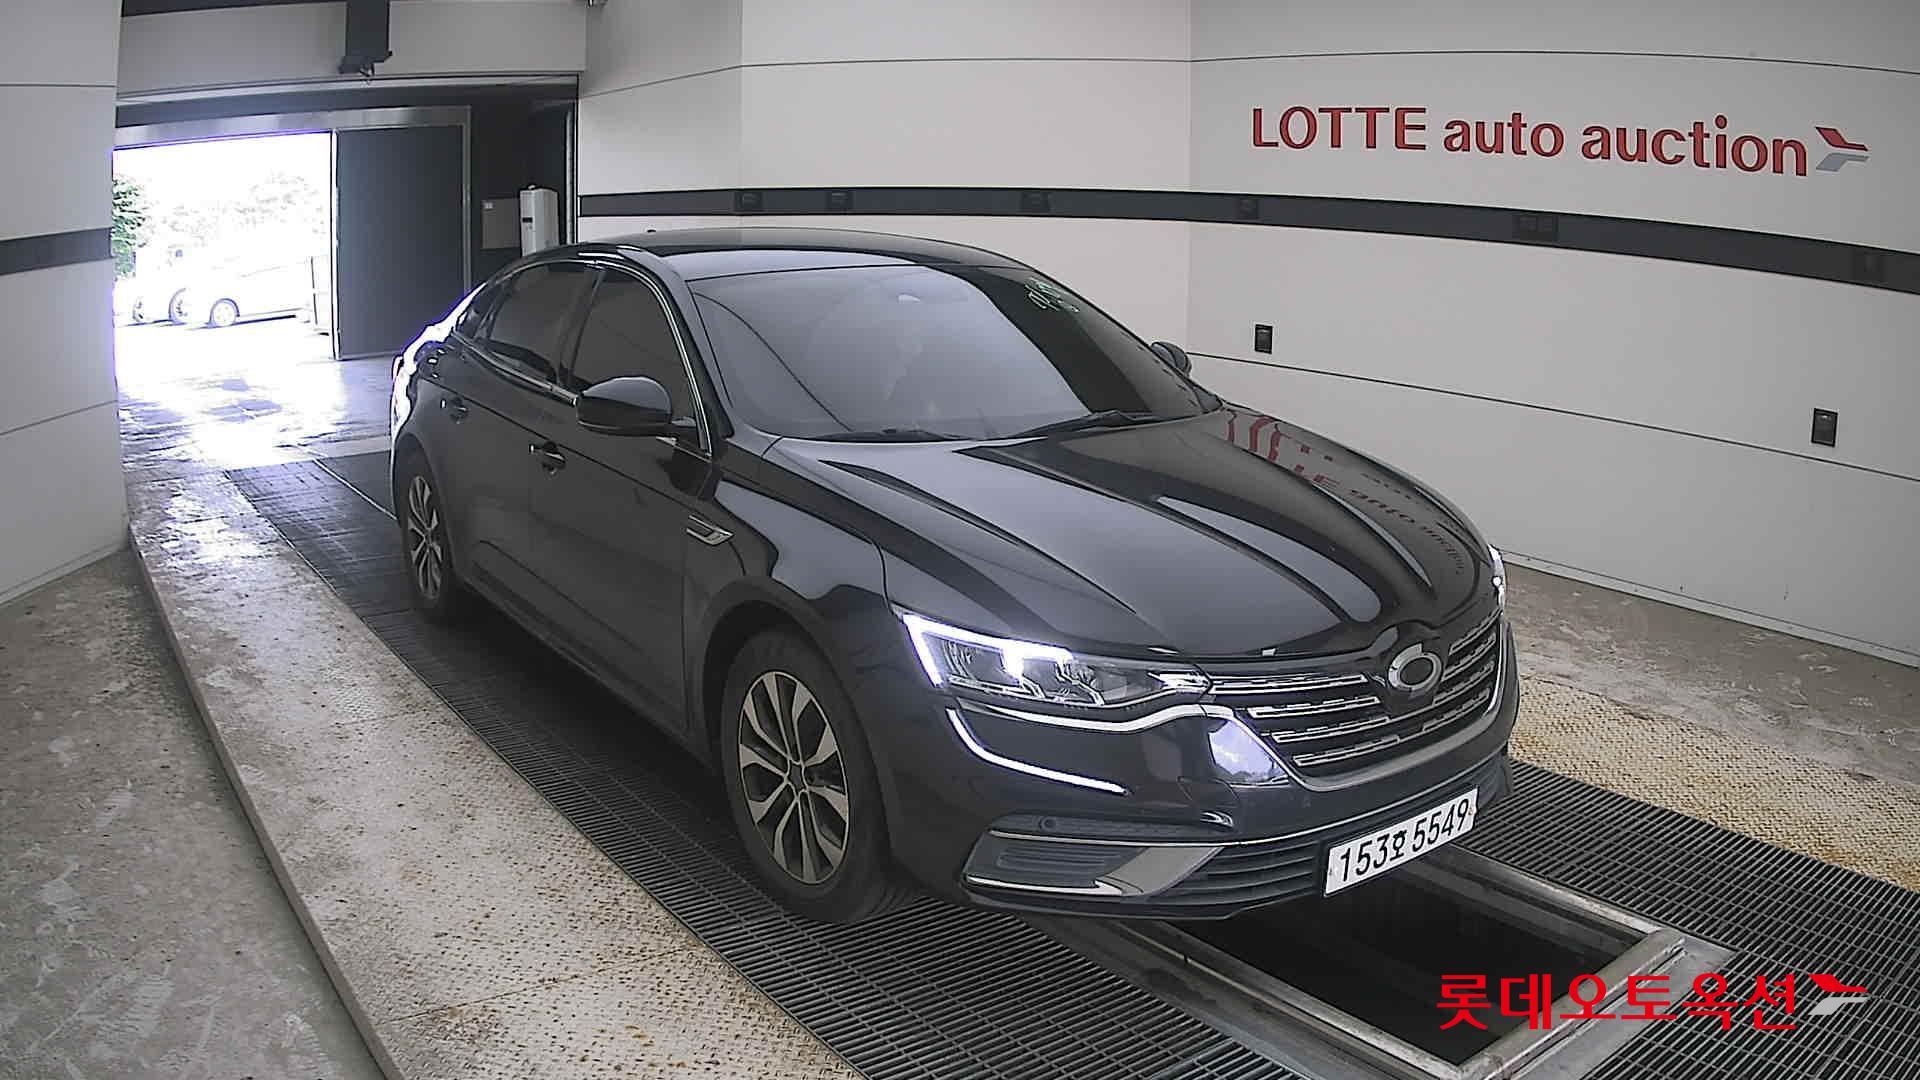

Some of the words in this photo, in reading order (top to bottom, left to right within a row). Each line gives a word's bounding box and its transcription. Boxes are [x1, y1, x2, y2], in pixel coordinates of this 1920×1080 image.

[1253, 106, 1426, 150] LOTTE
[1445, 113, 1565, 156] auto
[1581, 115, 1807, 176] auction
[1340, 829, 1407, 882] 153호
[1412, 798, 1469, 852] 5549
